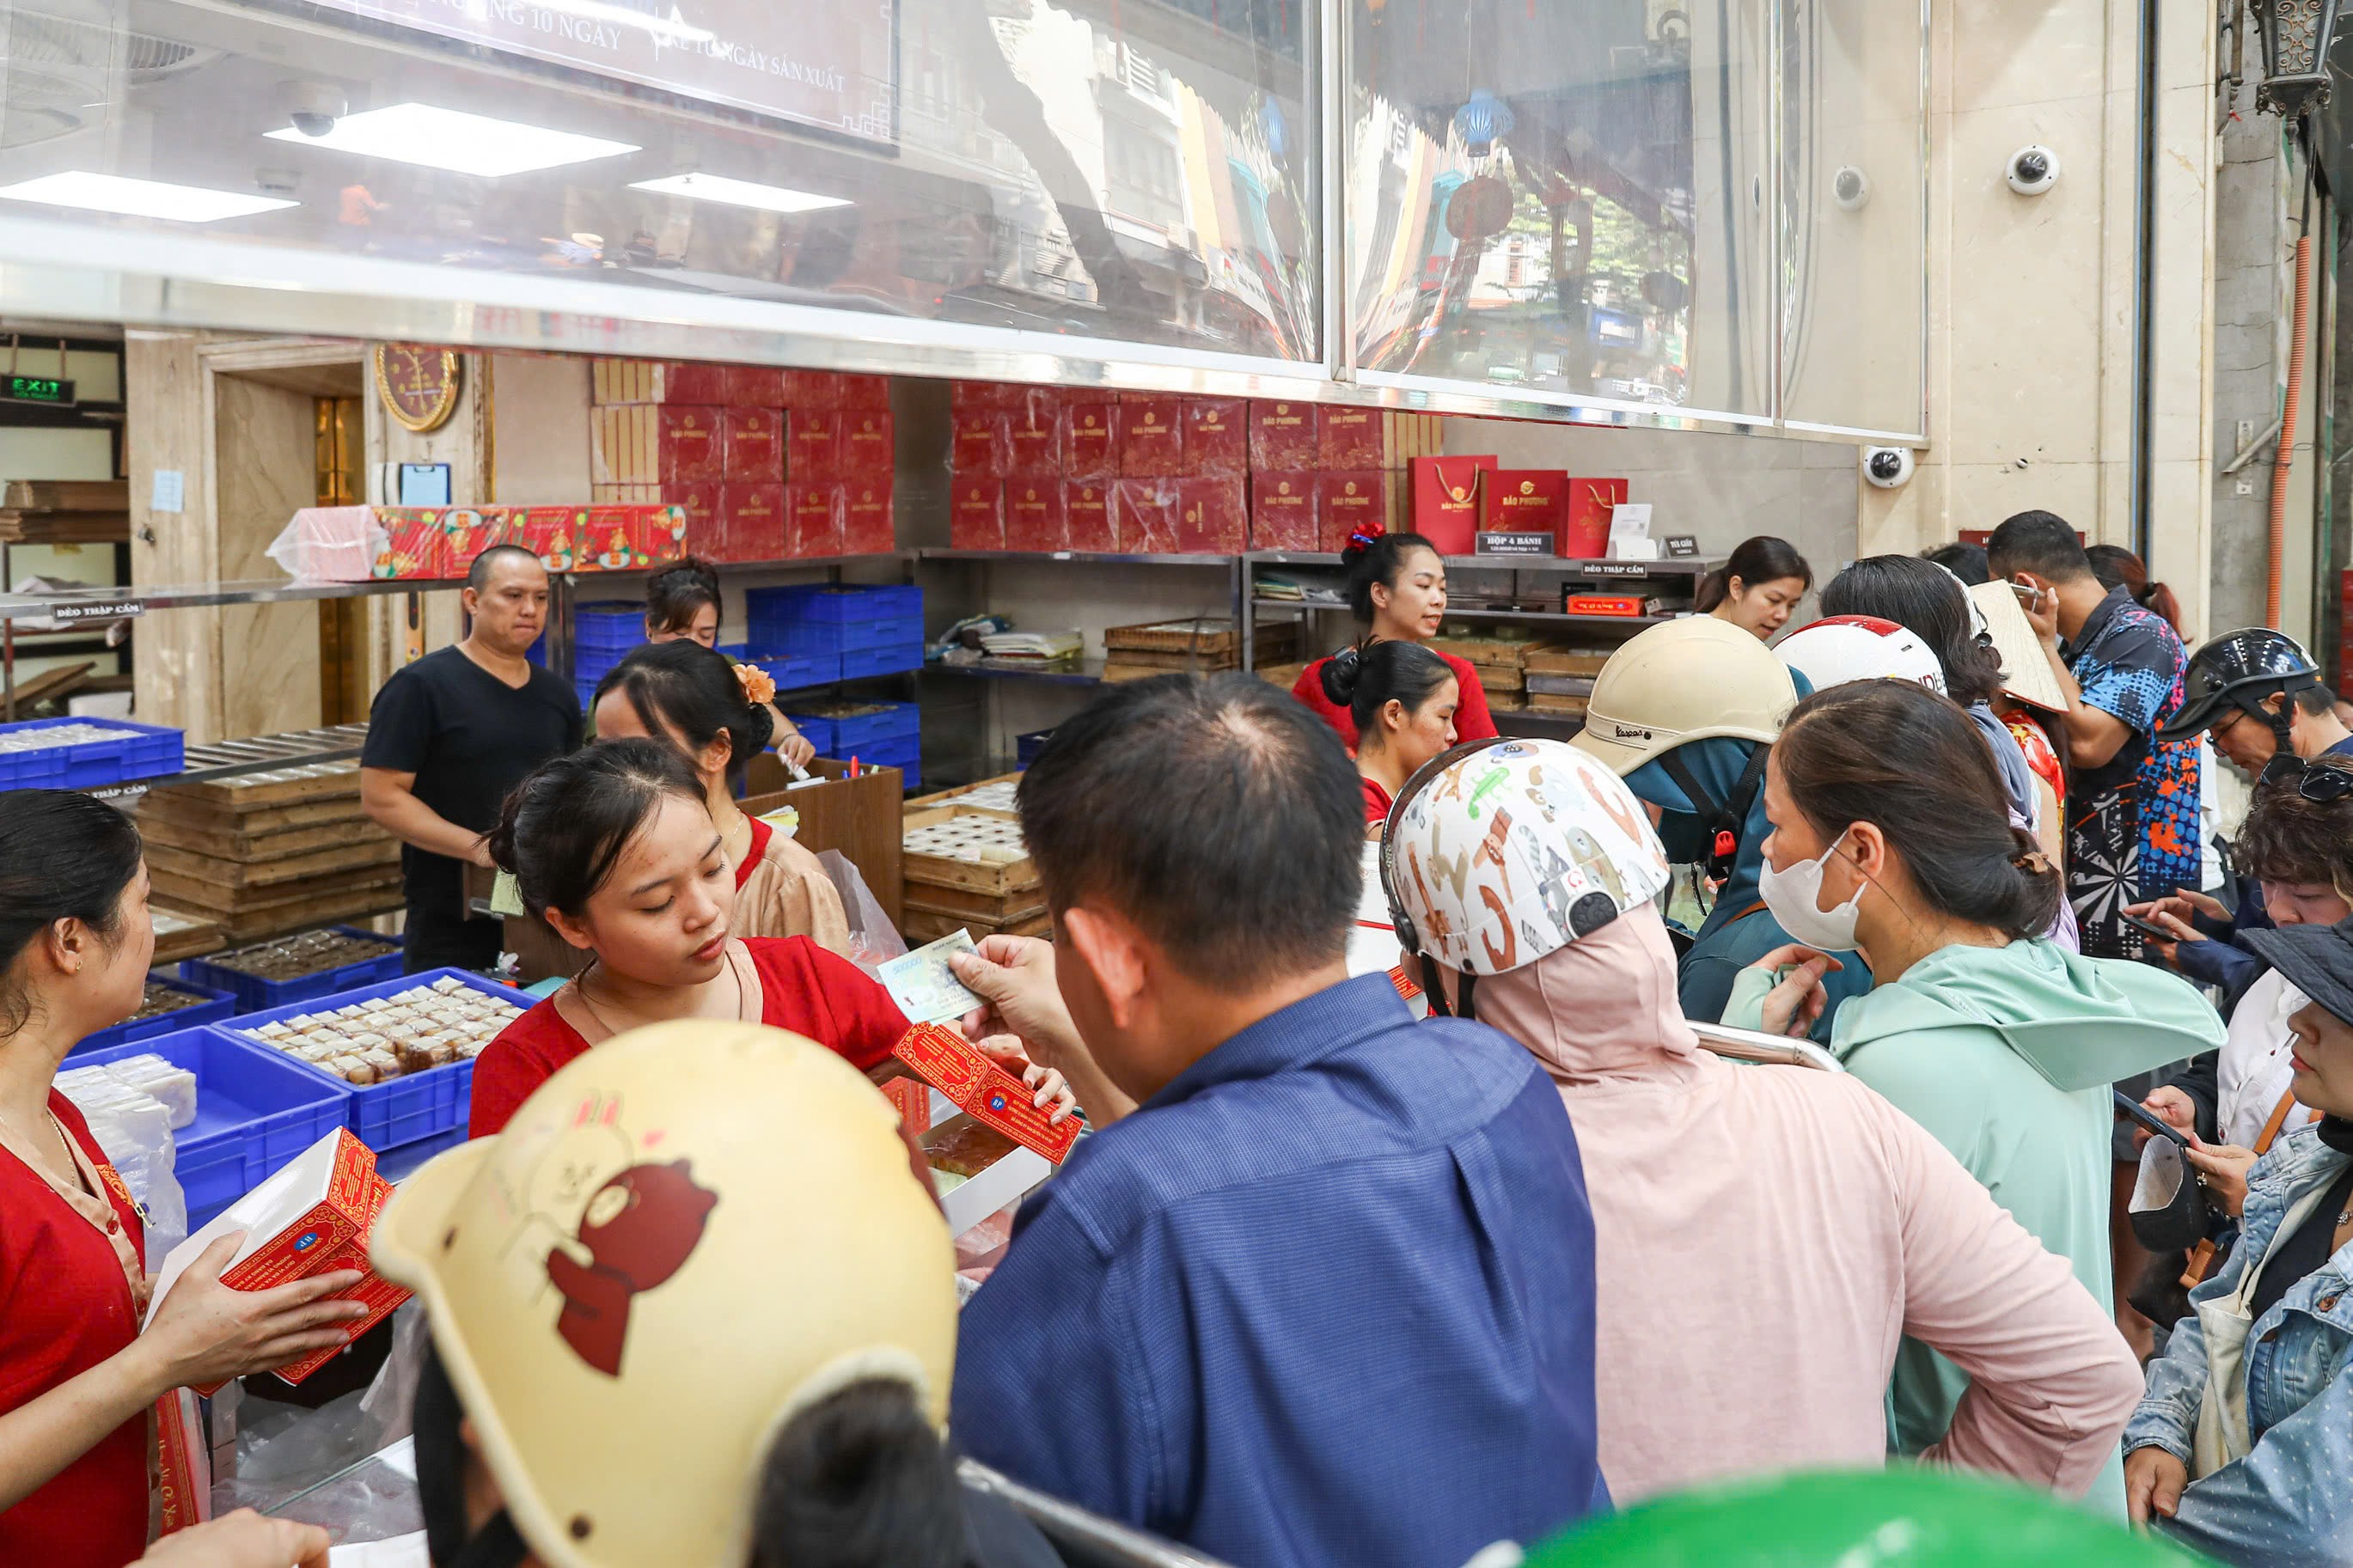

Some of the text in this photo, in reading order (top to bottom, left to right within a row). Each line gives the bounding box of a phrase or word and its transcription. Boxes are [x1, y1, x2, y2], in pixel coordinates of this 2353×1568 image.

[531, 9, 553, 33] 10
[559, 14, 620, 50] NGÀY
[771, 54, 802, 82] SẢN
[805, 65, 845, 93] XUẤT
[13, 379, 60, 393] EXIT
[1503, 497, 1518, 506] BẢO
[1487, 535, 1507, 546] HỘP
[1517, 536, 1542, 545] BÁNH
[1627, 564, 1644, 573] CẨM
[84, 605, 113, 615] THẬP
[115, 602, 139, 613] CẨM
